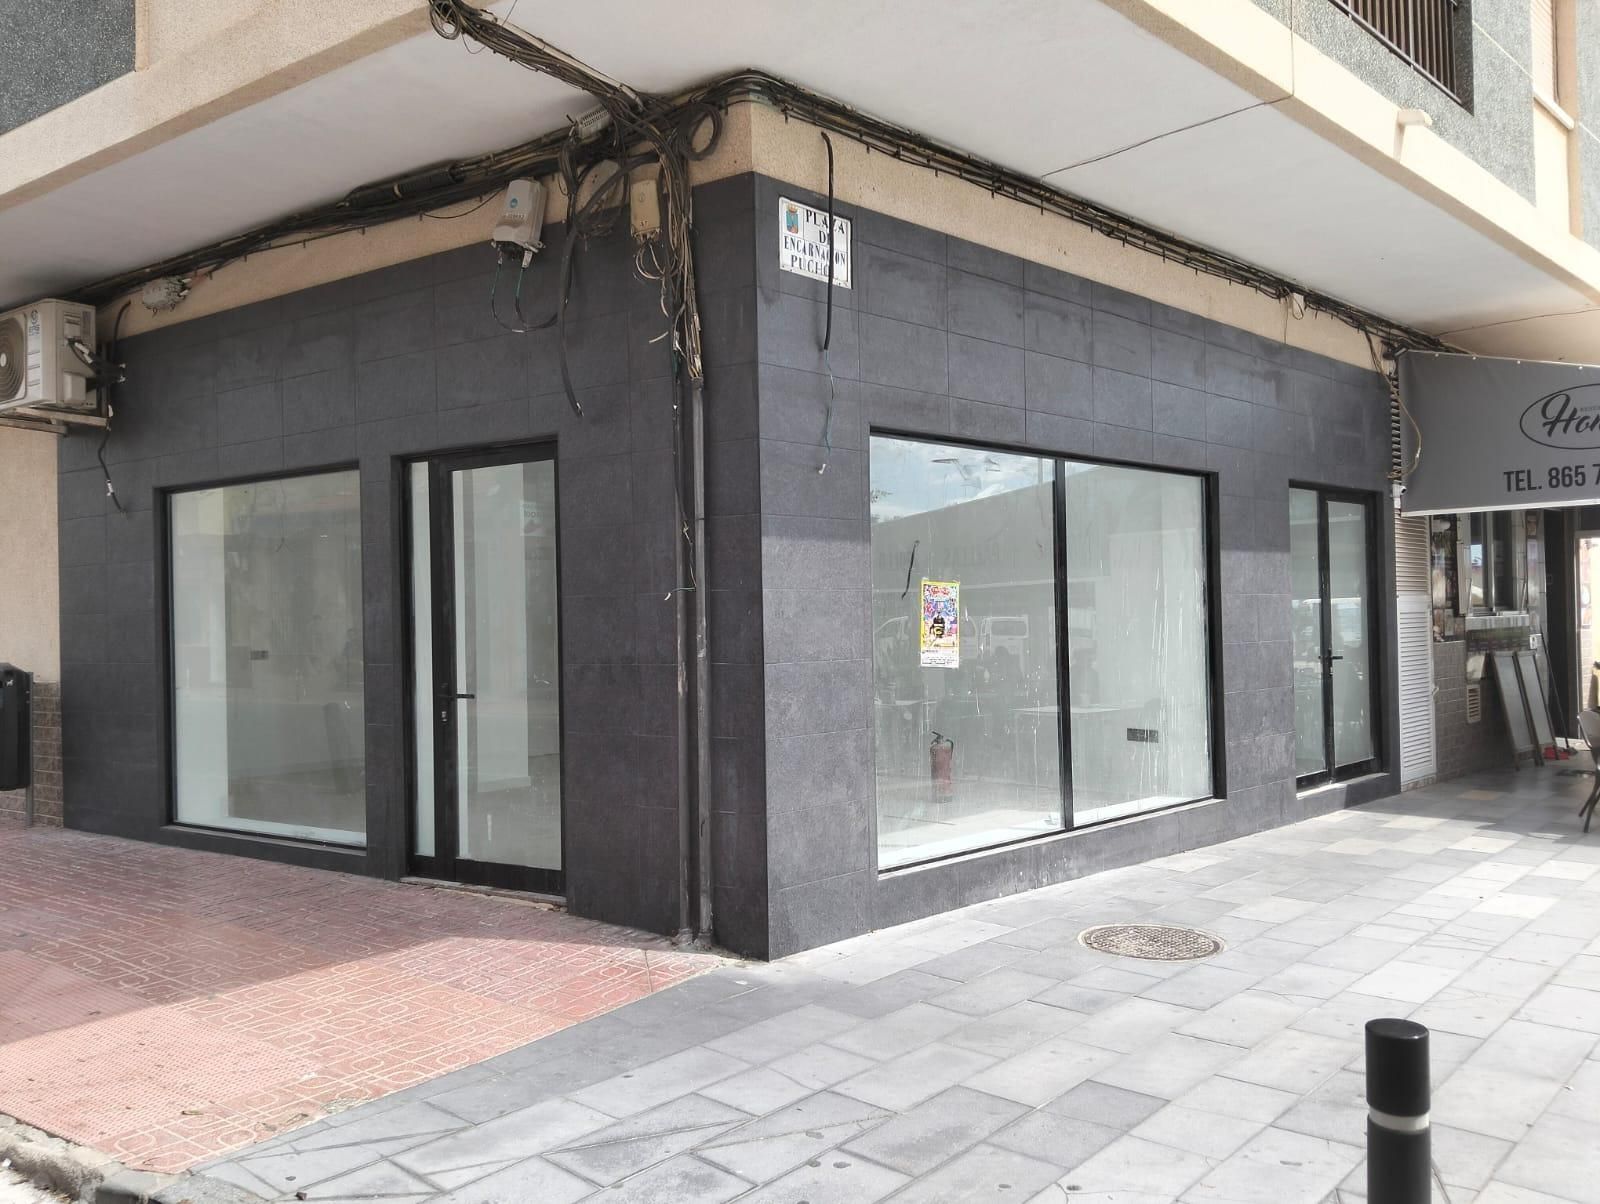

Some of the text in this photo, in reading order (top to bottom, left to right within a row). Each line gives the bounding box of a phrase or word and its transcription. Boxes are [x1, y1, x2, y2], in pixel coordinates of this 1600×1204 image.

[784, 235, 846, 265] ENCARNACON
[791, 254, 838, 278] PUCHO
[1503, 469, 1542, 492] TEL.
[1548, 465, 1586, 488] 865
